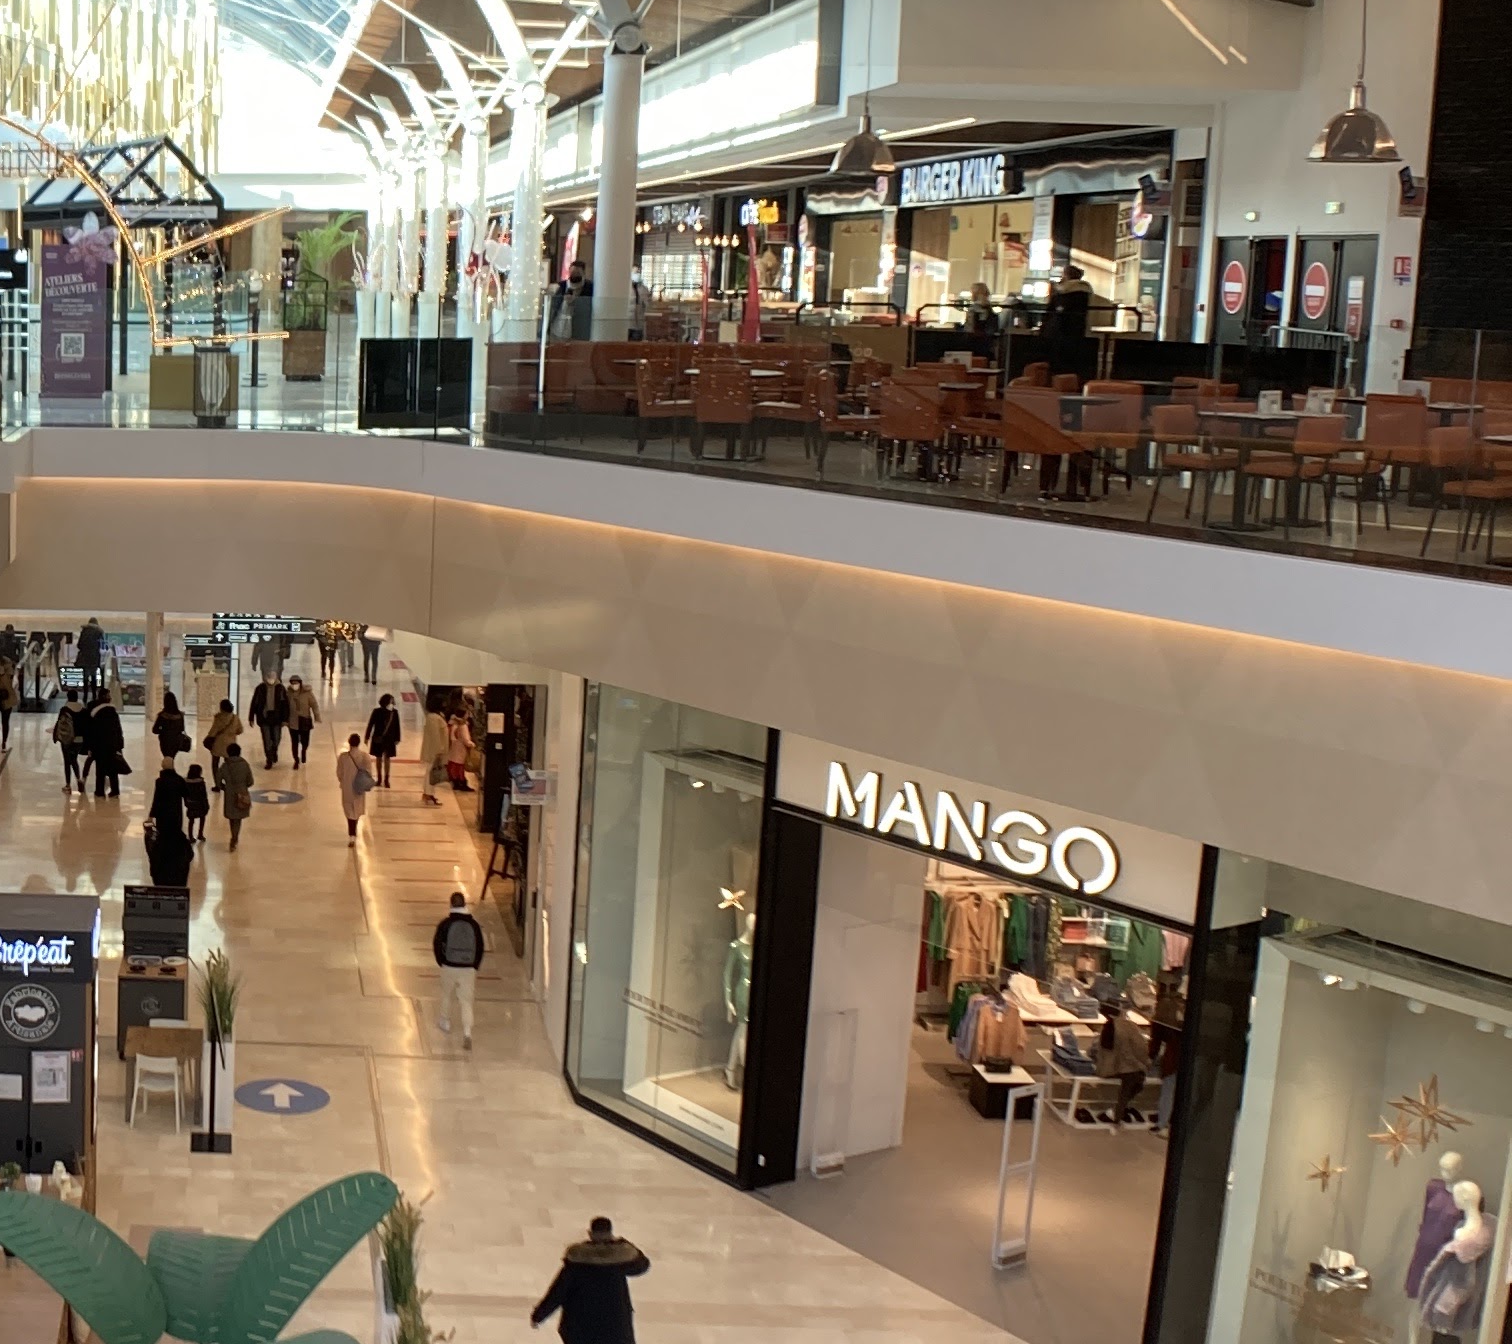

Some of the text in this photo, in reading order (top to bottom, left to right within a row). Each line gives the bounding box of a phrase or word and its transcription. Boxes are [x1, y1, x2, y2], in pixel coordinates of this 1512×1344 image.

[901, 154, 1006, 205] BURGER KING
[45, 273, 83, 287] ATELIERS
[253, 622, 288, 630] PRIMARK
[826, 760, 1120, 895] MANGO
